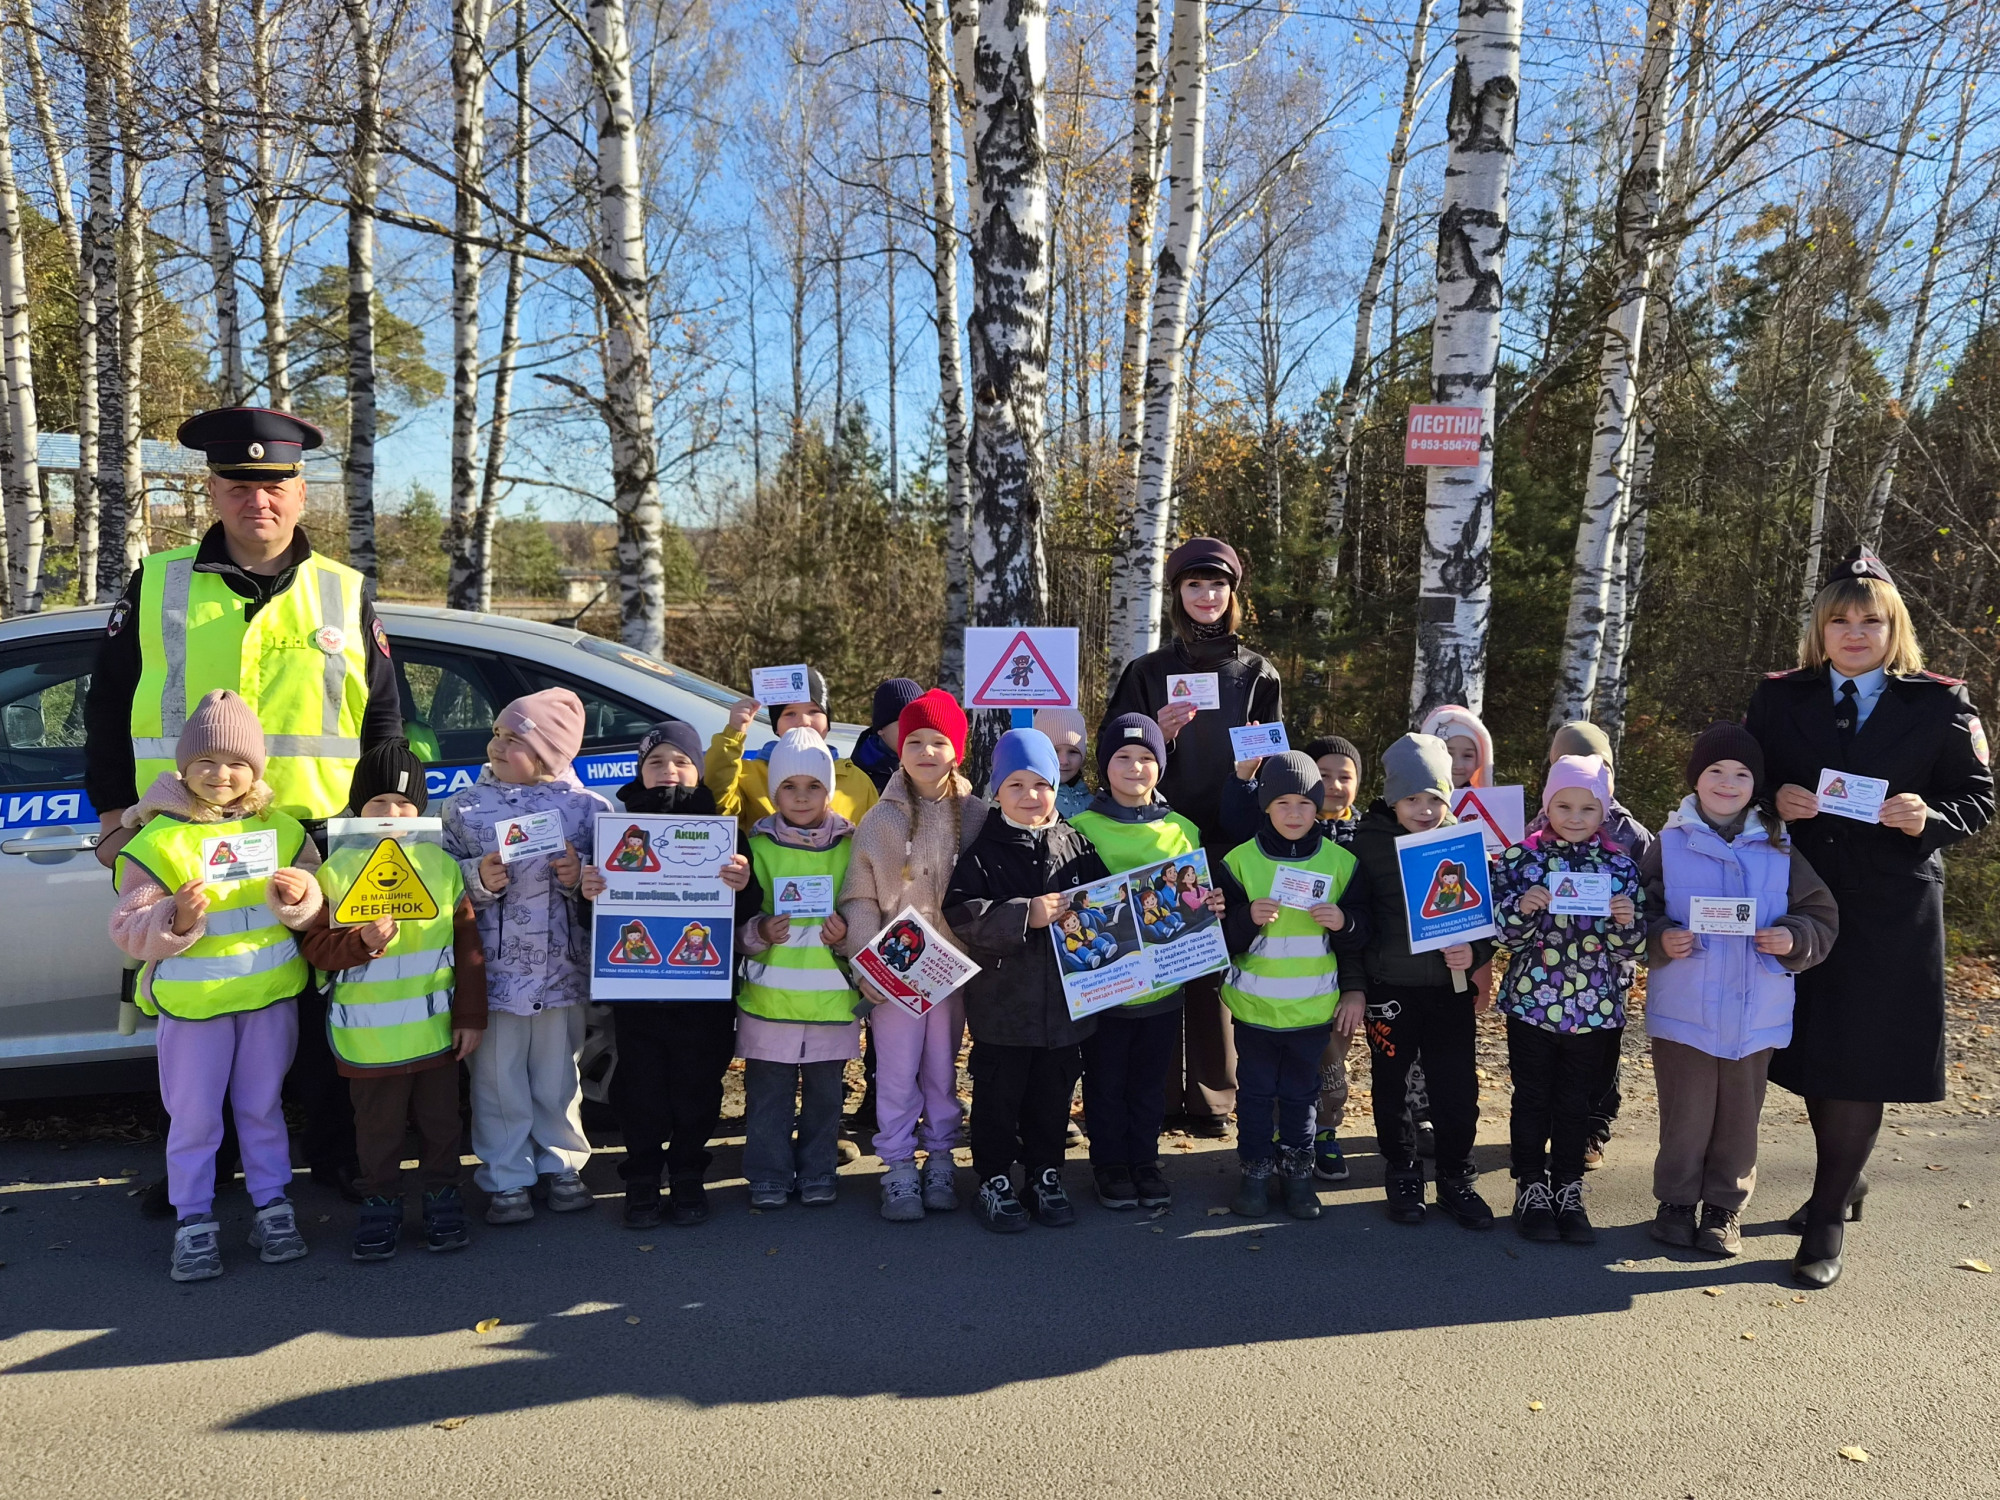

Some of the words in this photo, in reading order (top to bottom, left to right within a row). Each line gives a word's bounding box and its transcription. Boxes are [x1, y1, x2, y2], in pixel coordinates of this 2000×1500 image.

[1411, 414, 1479, 434] ЛЕСТНИ
[0, 794, 80, 828] ИЯ
[675, 829, 709, 841] Акция
[371, 892, 413, 900] МАШИНЕ
[610, 890, 633, 900] Если
[635, 890, 680, 902] любишь,
[682, 890, 720, 902] береги!
[351, 901, 423, 916] РЕБЁНОК
[1422, 922, 1440, 932] ЧТОБЫ
[1440, 916, 1468, 928] ИЗБЕЖАТЬ
[1160, 944, 1176, 953] кресле
[930, 943, 968, 974] МАМОЧКА
[938, 957, 953, 970] ЕСЛИ
[1153, 955, 1163, 963] Всё
[1158, 955, 1190, 970] Пристегнули
[921, 960, 953, 985] ПРИСТЕГНИ
[1173, 963, 1187, 972] папой
[921, 968, 943, 986] МЕНЯ!
[1069, 976, 1088, 987] Кресло
[1093, 968, 1111, 978] верный
[1112, 965, 1123, 973] друг
[1081, 978, 1105, 989] Помогает
[1080, 983, 1112, 998] Пристегнули
[1091, 990, 1113, 1000] поездка
